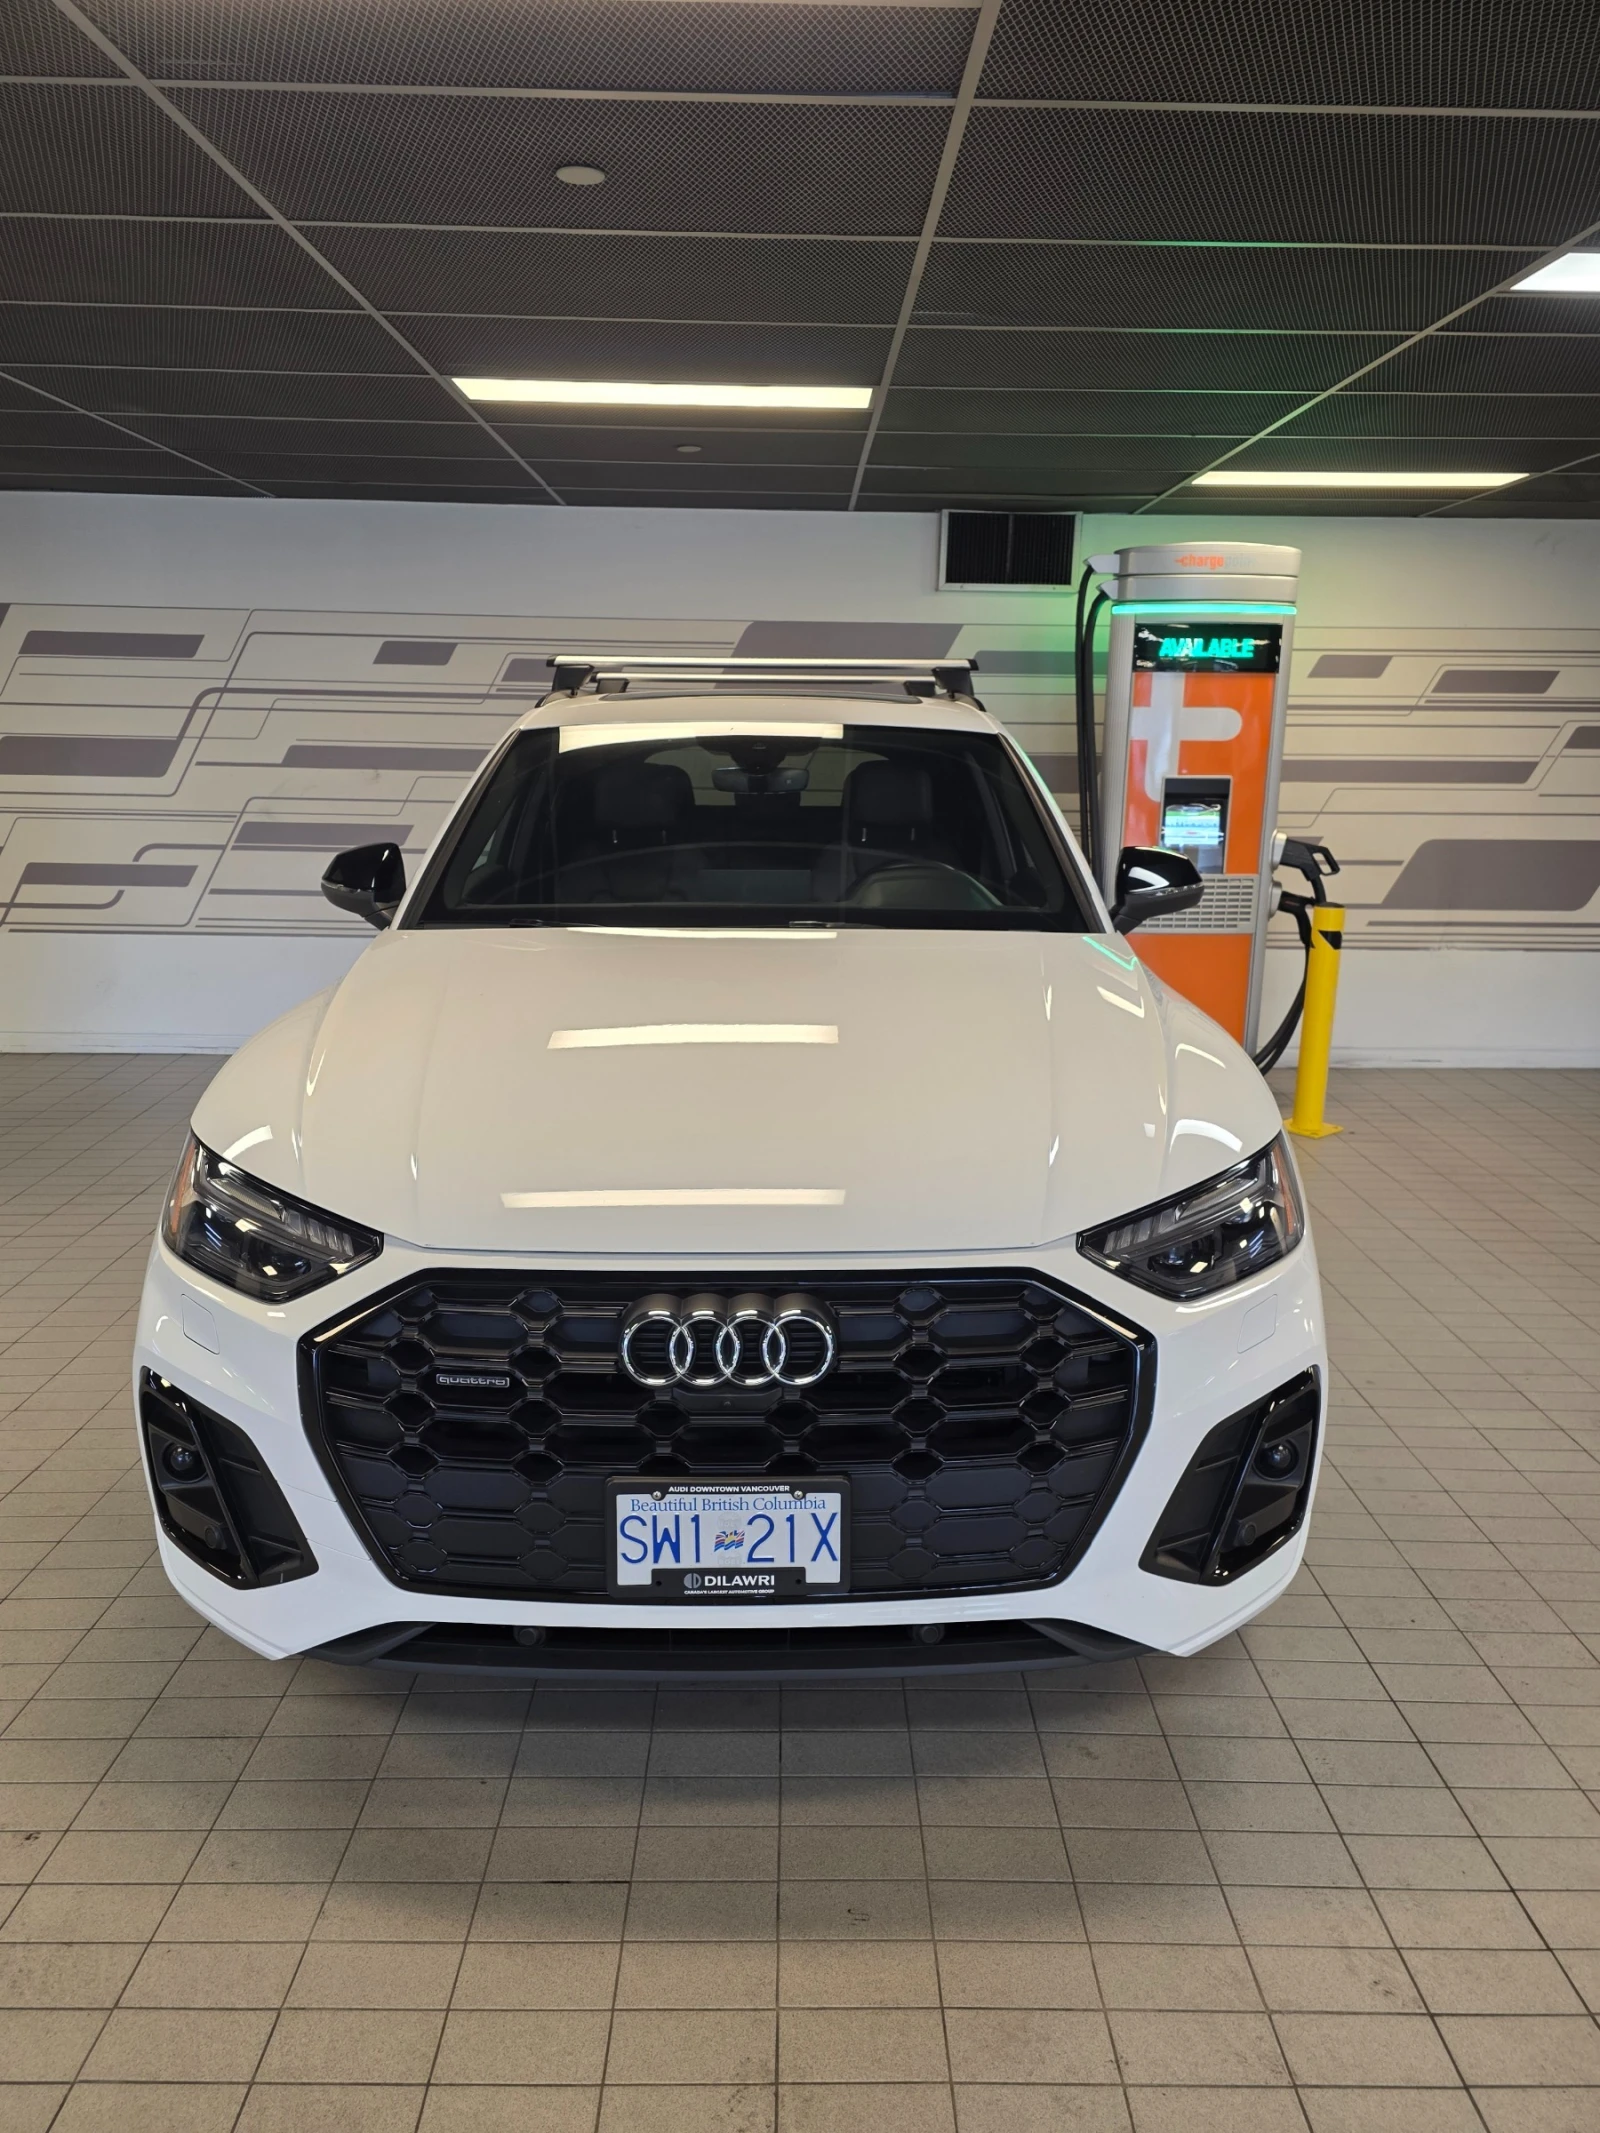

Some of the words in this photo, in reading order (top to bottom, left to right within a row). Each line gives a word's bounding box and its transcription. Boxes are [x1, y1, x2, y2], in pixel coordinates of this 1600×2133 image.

[1159, 637, 1255, 657] AVAILABLE
[439, 1376, 506, 1385] quattro
[631, 1497, 697, 1512] Beautiful
[702, 1497, 749, 1511] British
[753, 1496, 826, 1511] Columbia
[619, 1514, 700, 1564] SW1
[746, 1512, 838, 1563] 21X
[704, 1575, 775, 1586] DILAWRI
